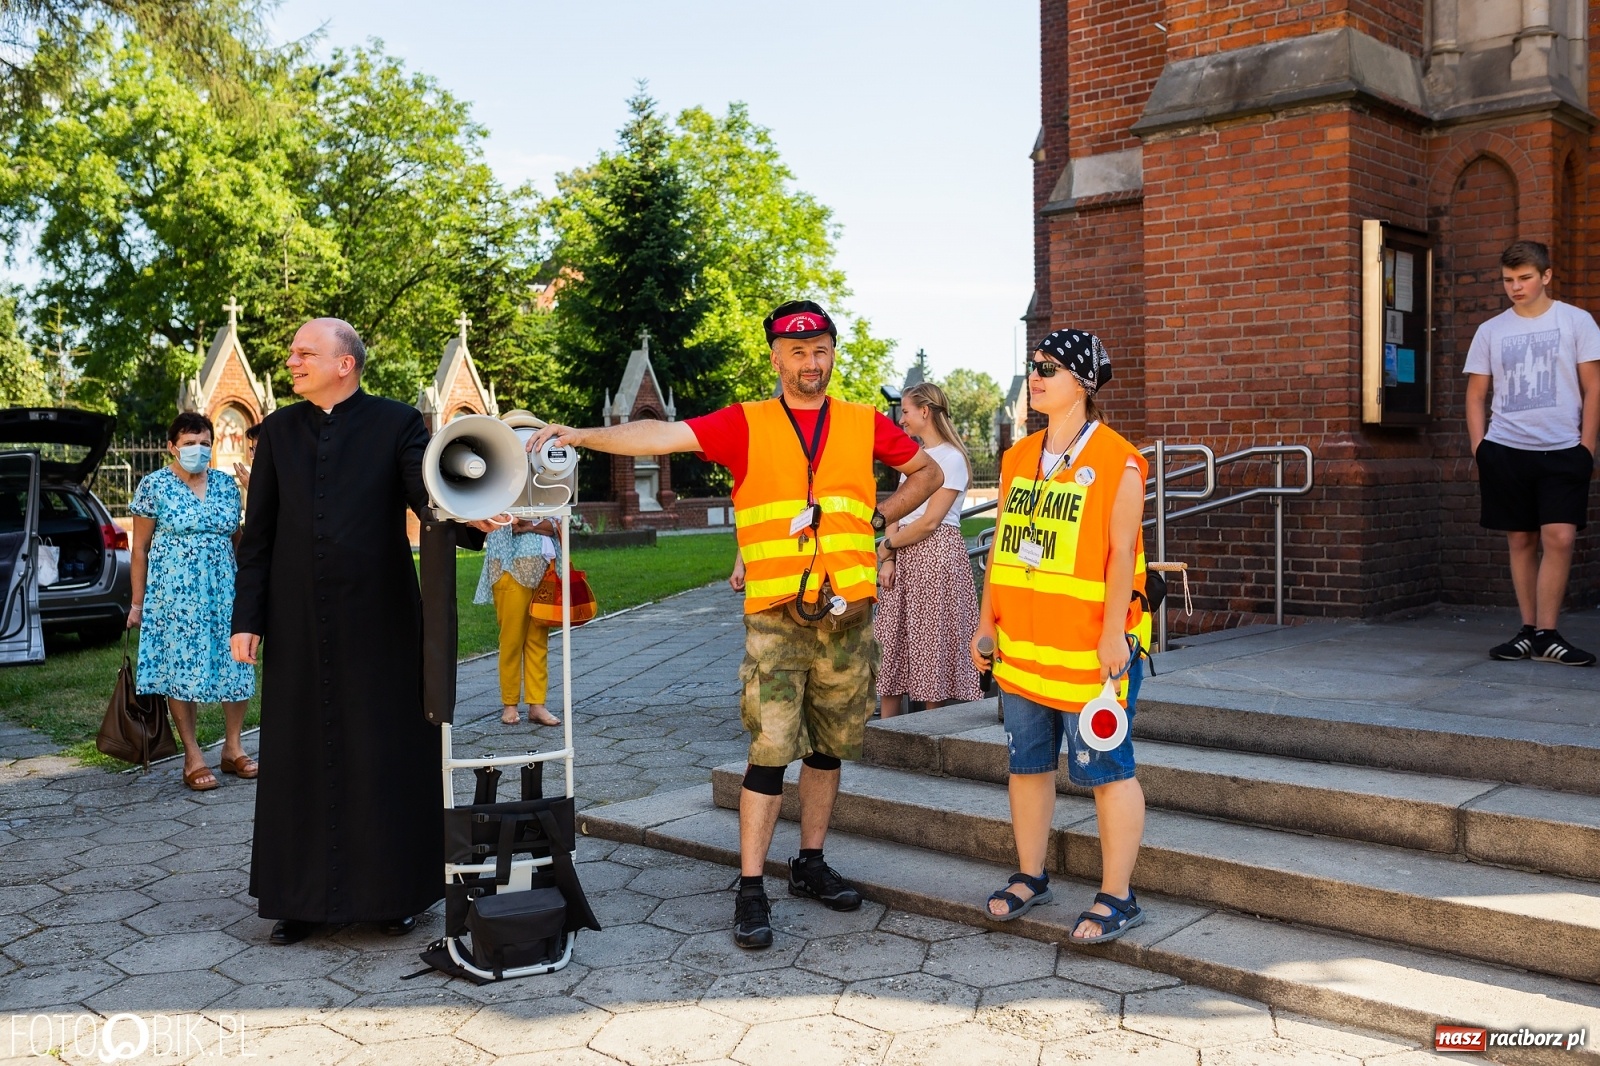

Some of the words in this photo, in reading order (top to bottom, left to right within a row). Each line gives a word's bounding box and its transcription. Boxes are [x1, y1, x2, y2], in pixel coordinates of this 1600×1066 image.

[796, 320, 805, 332] 5
[1502, 335, 1527, 347] NEVER
[1529, 330, 1559, 345] ENOUGH
[1004, 486, 1082, 523] IEROANIE
[1000, 524, 1057, 560] RUCEM
